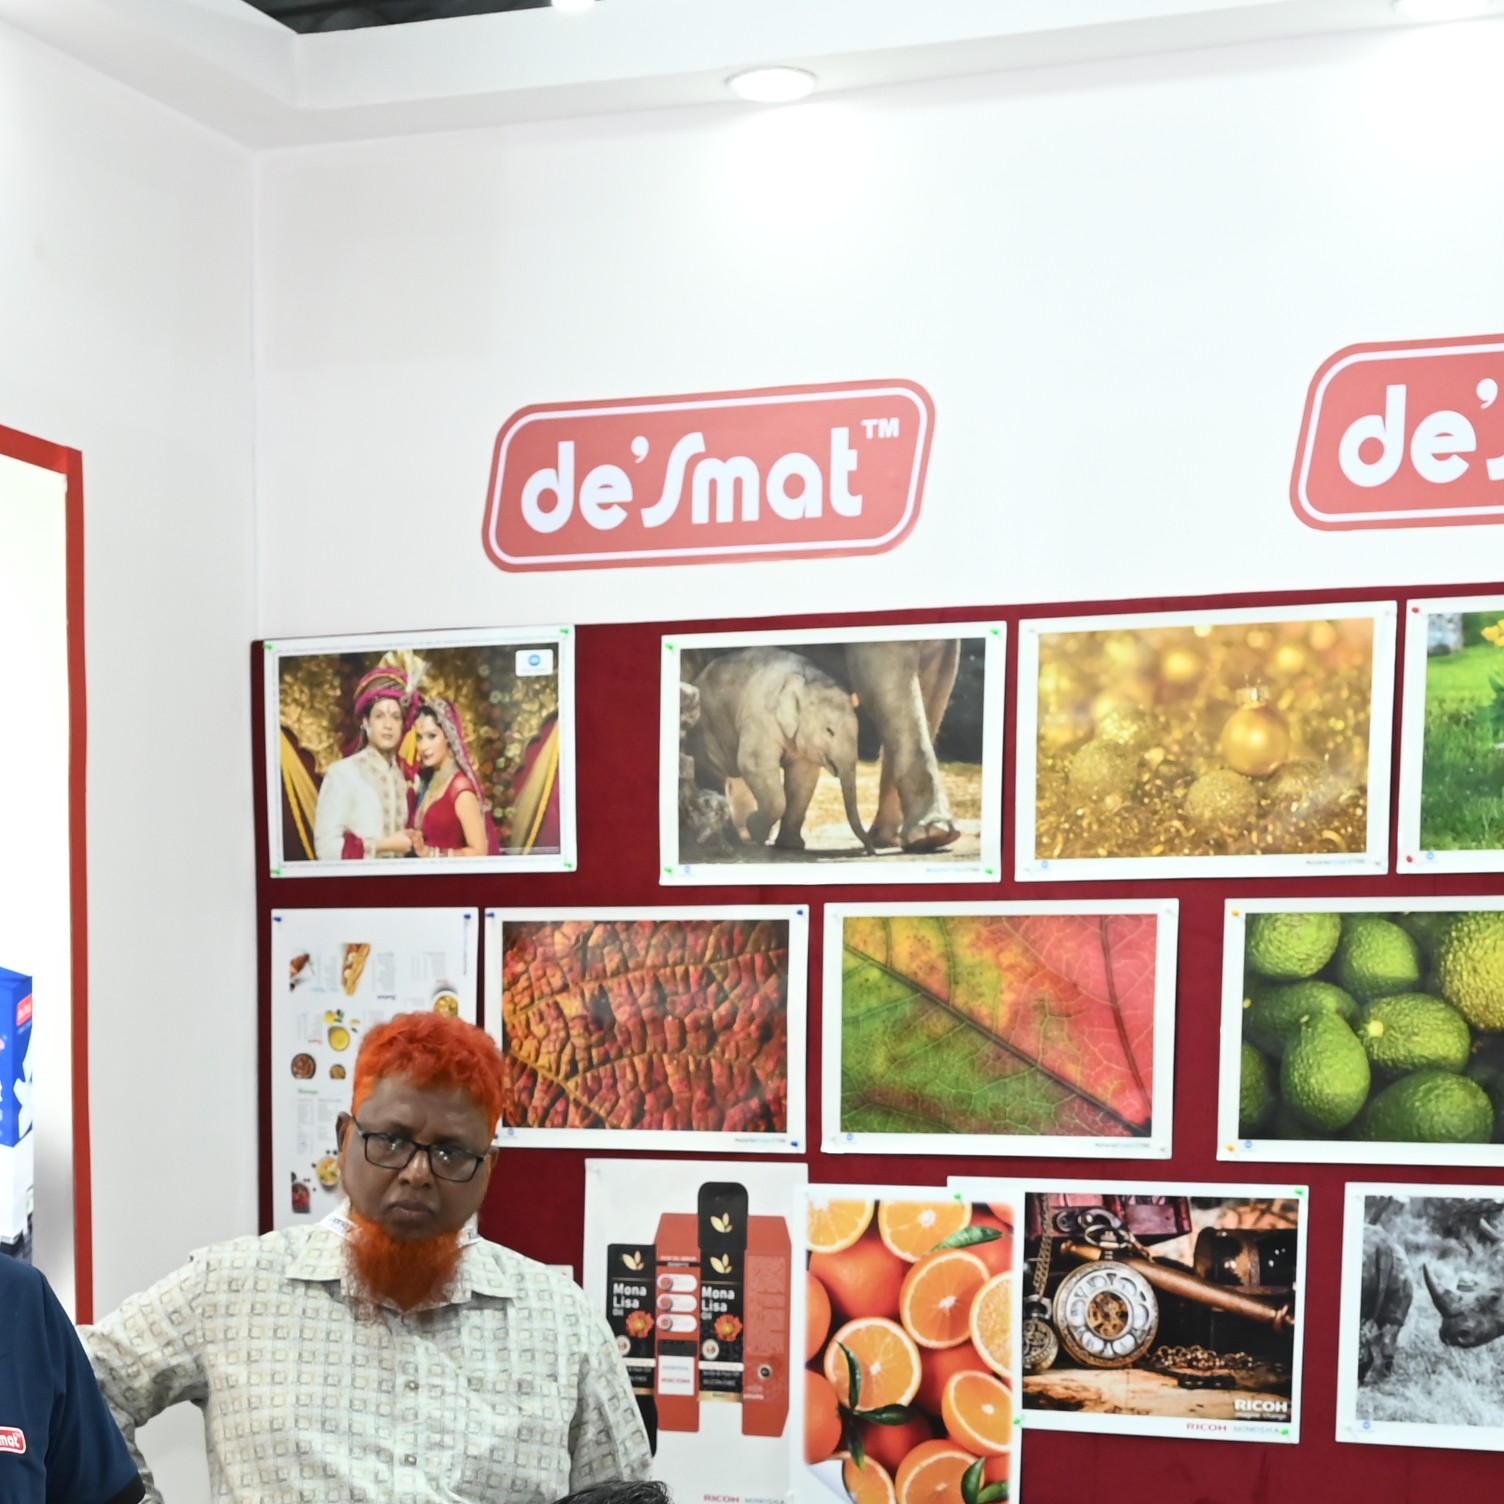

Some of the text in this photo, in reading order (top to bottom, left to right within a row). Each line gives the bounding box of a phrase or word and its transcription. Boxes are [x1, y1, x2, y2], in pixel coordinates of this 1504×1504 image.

[613, 1283, 647, 1296] Mona
[701, 1286, 735, 1300] Mona
[613, 1296, 640, 1309] Lisa
[701, 1300, 728, 1313] Lisa
[1235, 1399, 1288, 1413] RICOH
[1187, 1422, 1227, 1432] RICOH
[703, 1493, 740, 1503] RICOH
